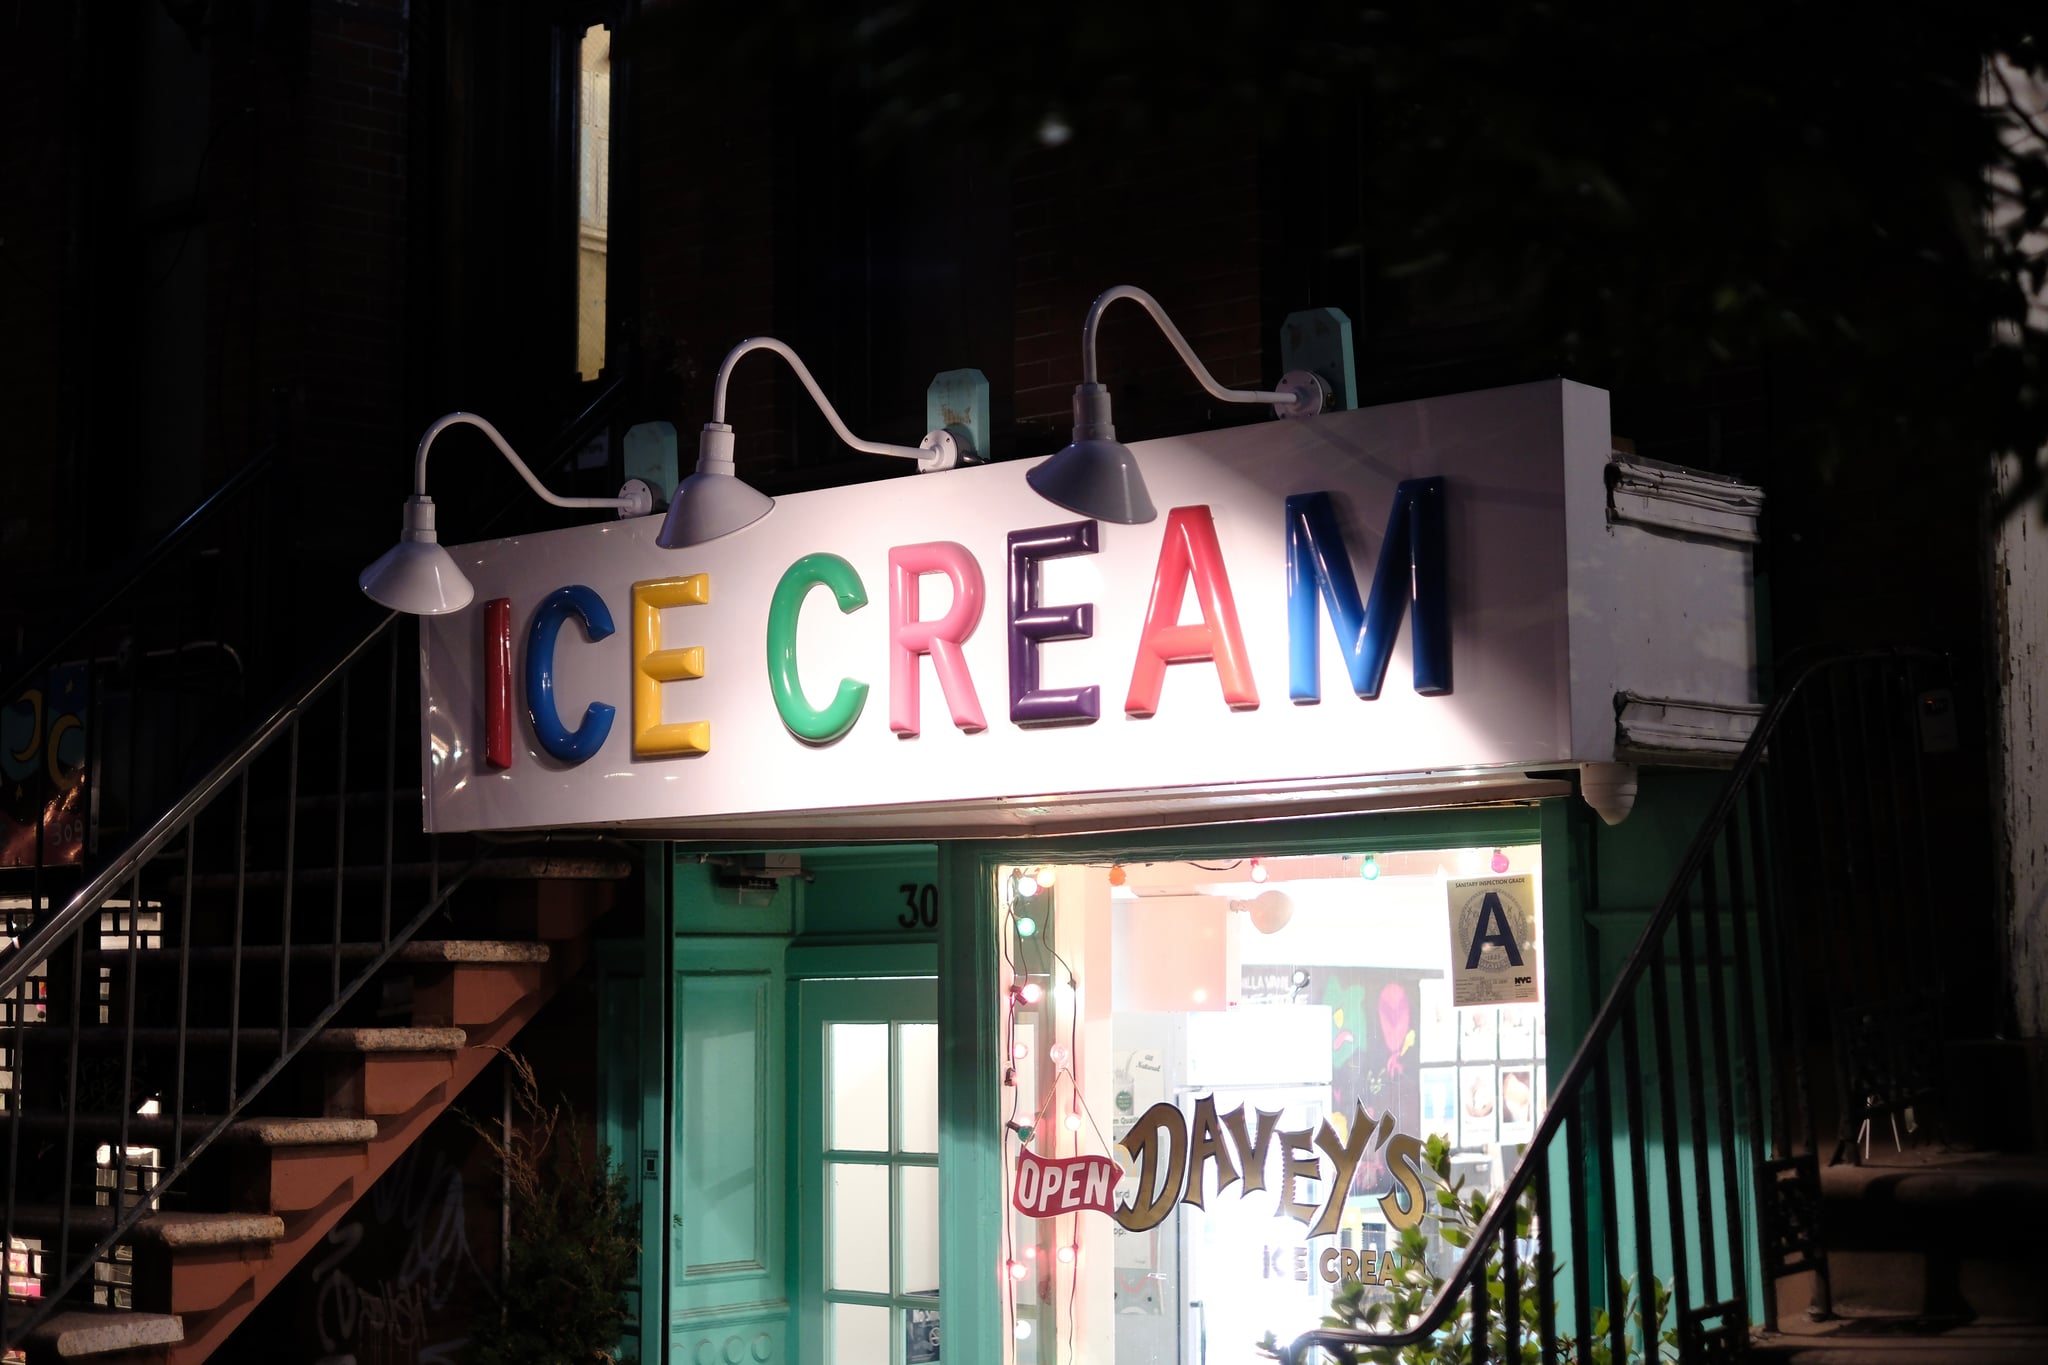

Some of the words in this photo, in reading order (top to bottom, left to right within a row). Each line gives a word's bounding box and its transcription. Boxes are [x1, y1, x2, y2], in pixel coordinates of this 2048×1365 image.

[484, 572, 710, 769] ICE
[765, 475, 1455, 745] CREAM
[898, 883, 938, 929] 30
[1465, 892, 1524, 969] A
[1514, 976, 1532, 985] NYC
[1018, 1158, 1110, 1212] OPEN
[1114, 1093, 1428, 1241] DAVEY'S
